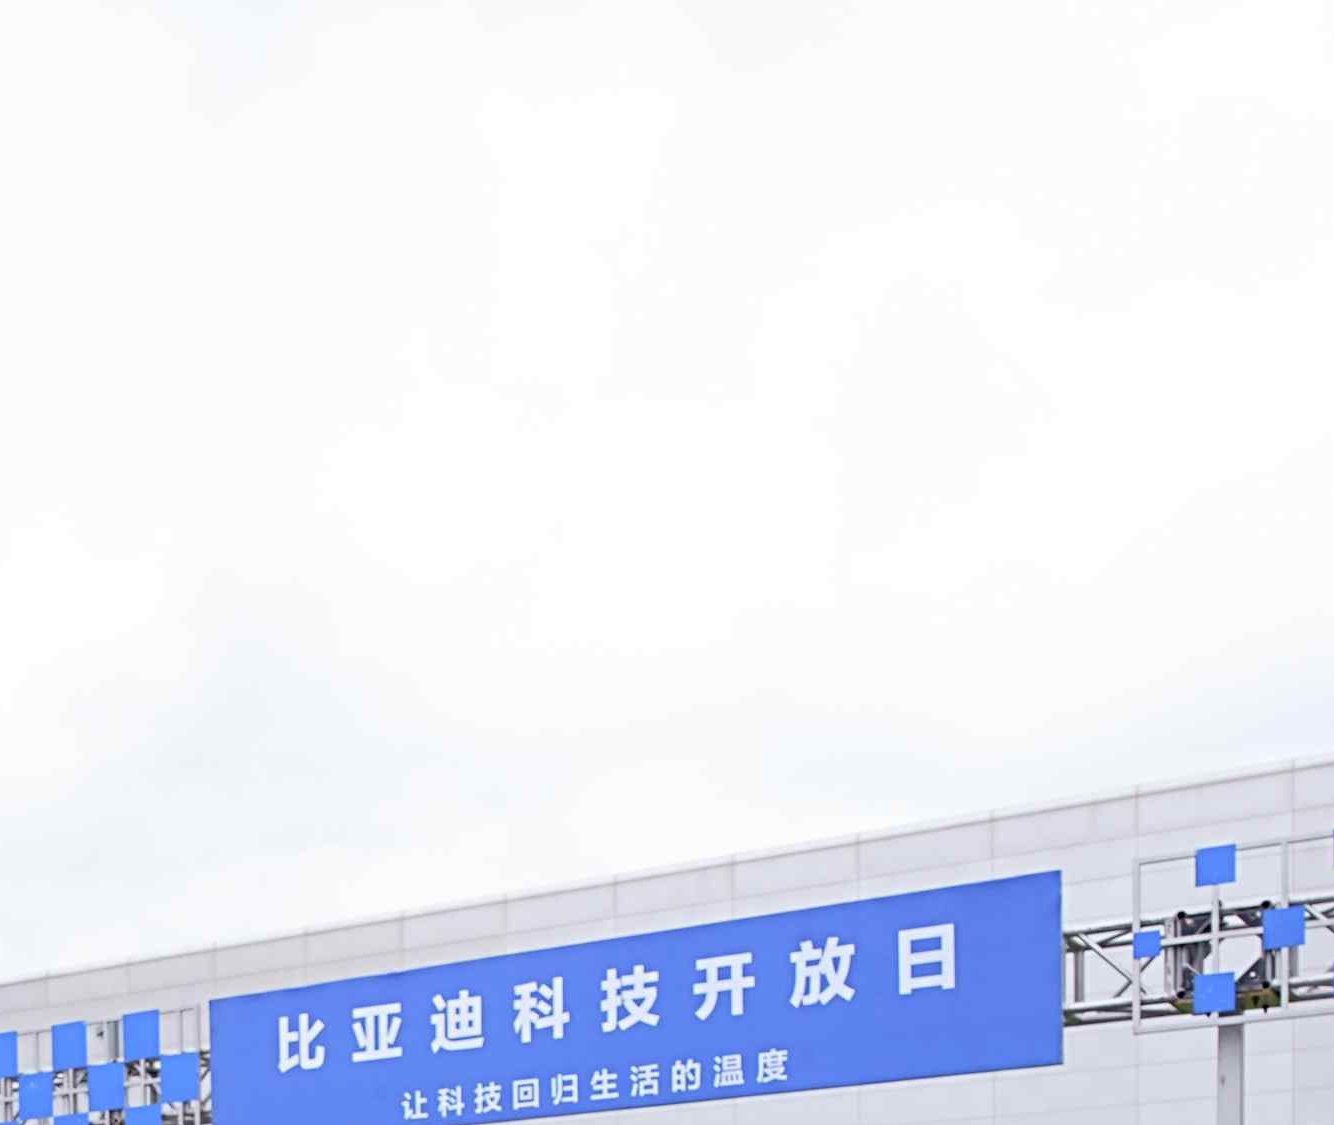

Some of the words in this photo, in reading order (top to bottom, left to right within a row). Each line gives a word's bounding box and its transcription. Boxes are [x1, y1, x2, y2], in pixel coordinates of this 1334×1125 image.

[277, 922, 957, 1073] 比亚迪科技开放日
[400, 1048, 789, 1120] 让科技回归生活的温度
